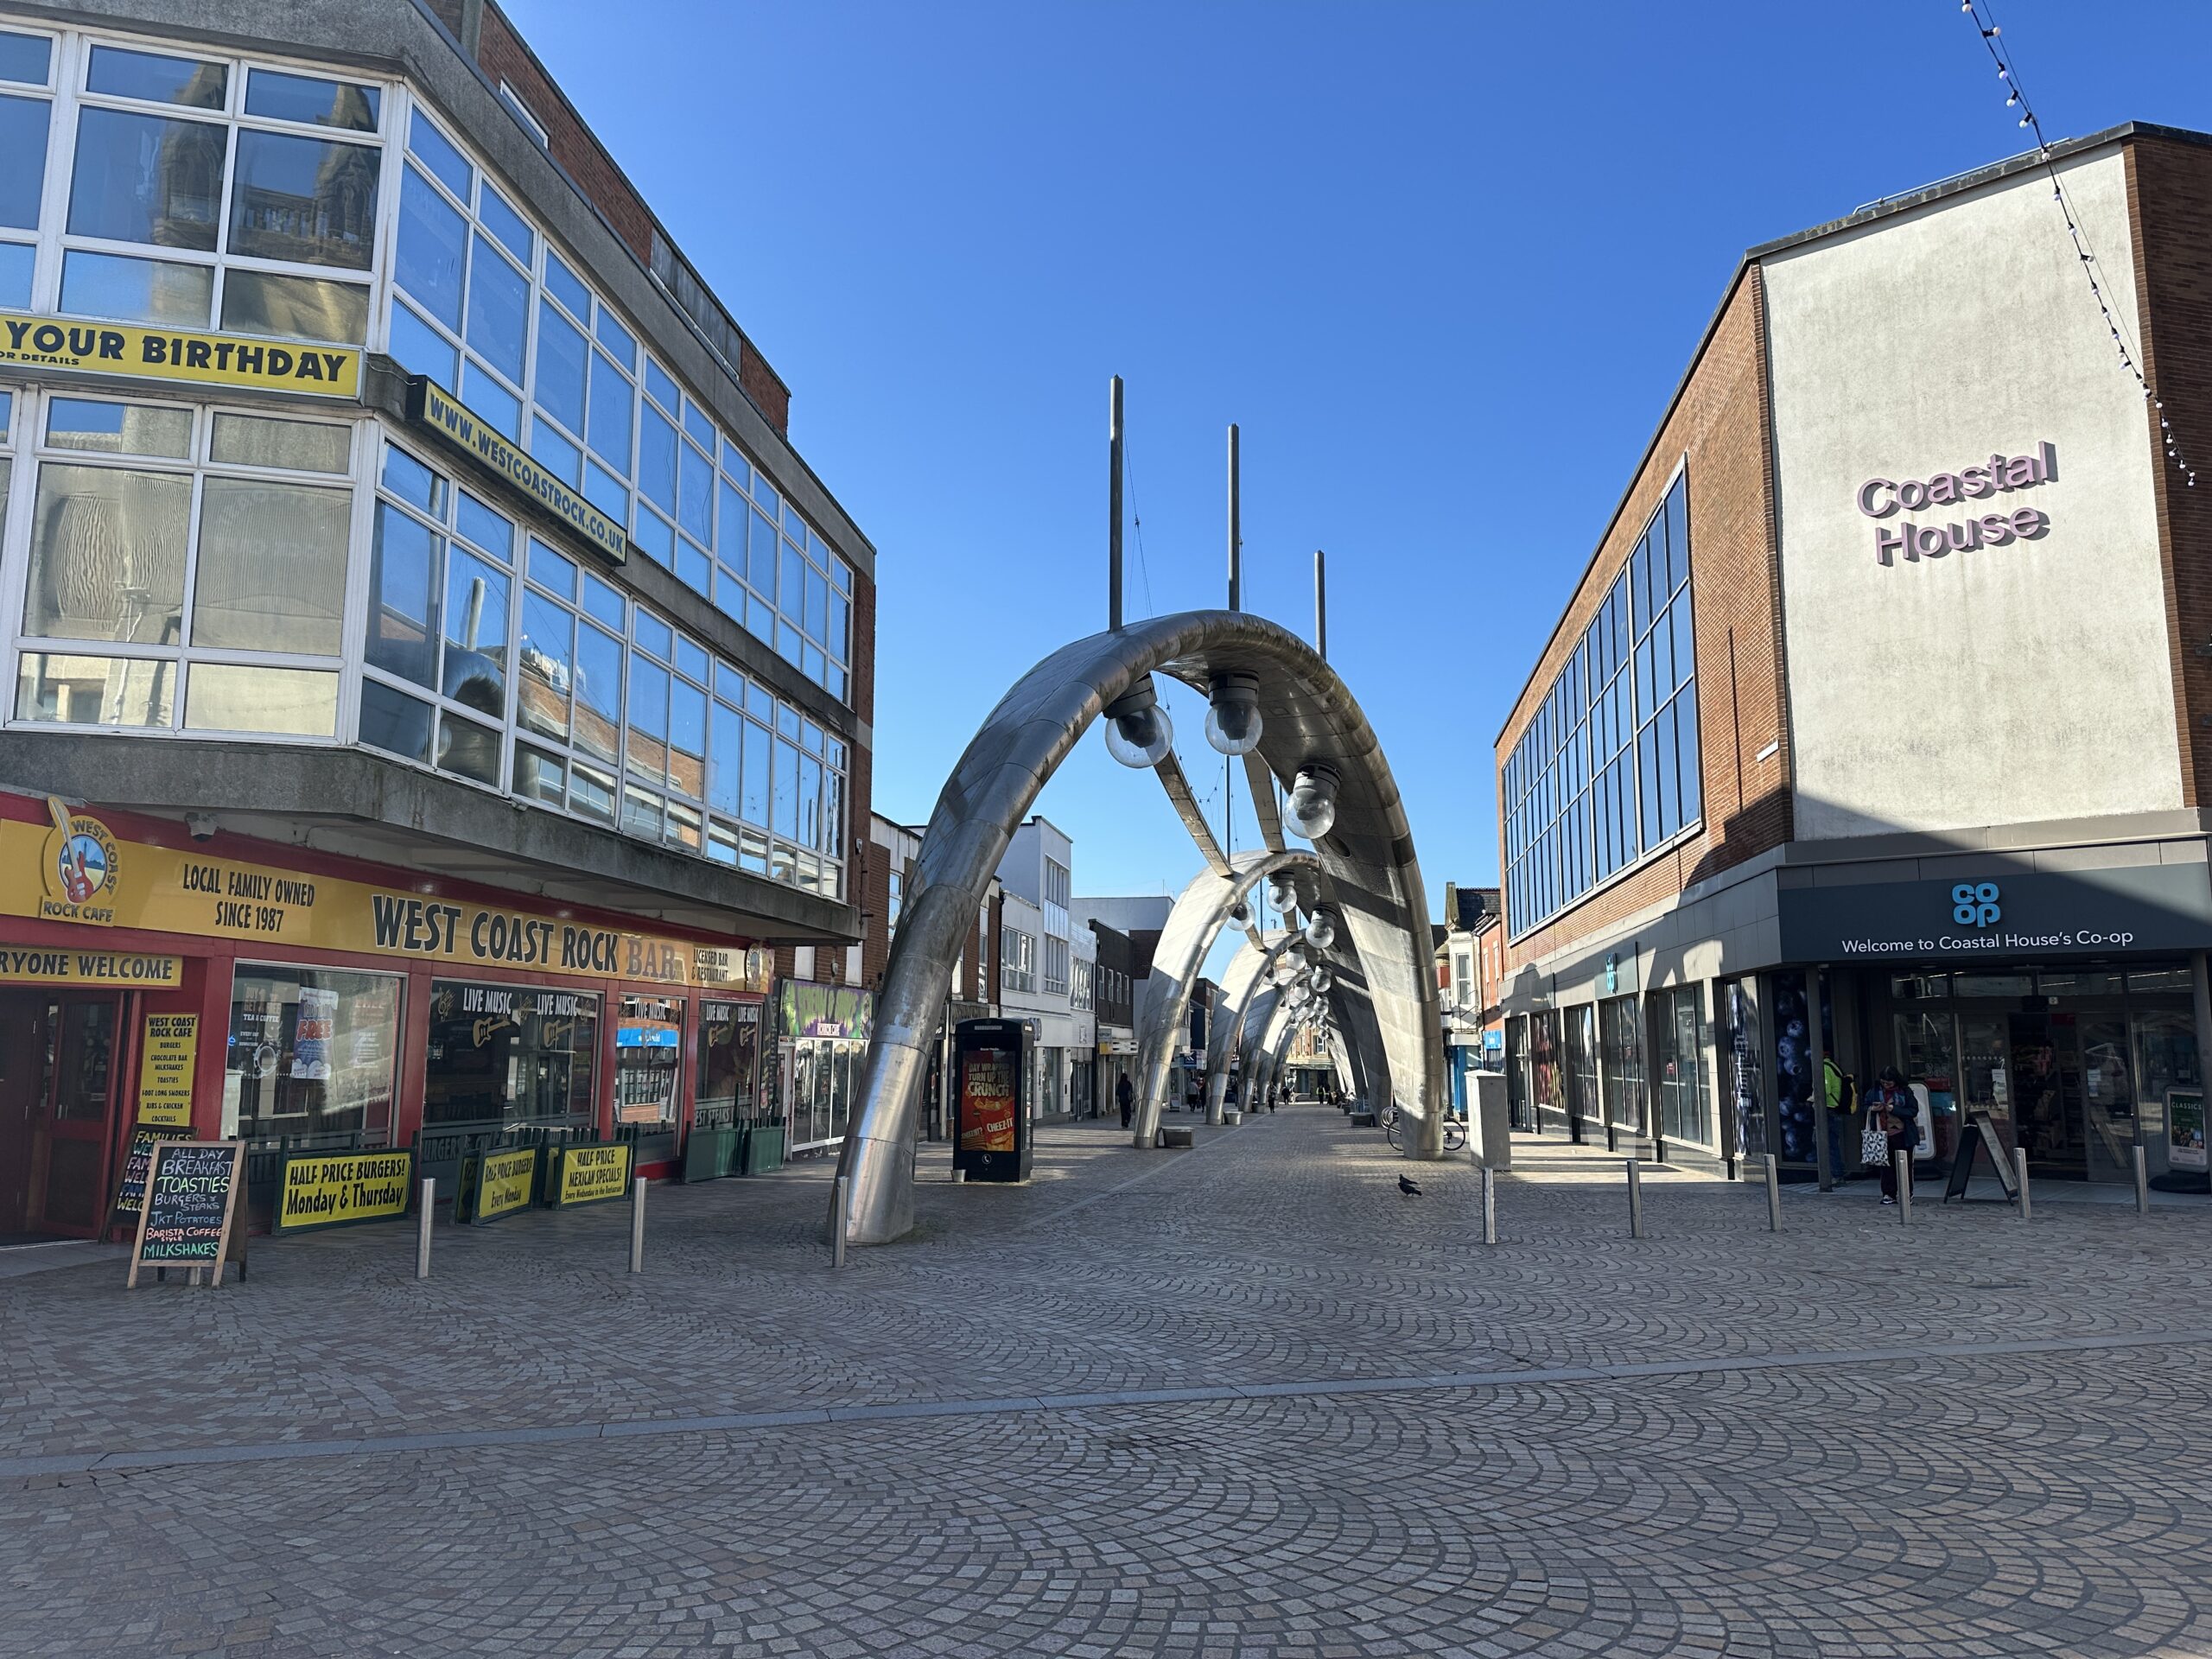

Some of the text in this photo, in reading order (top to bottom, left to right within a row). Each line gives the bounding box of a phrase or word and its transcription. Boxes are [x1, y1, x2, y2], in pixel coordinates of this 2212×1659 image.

[5, 321, 347, 382] YOUR BIRTHDAY
[22, 353, 79, 365] DETAILS
[430, 393, 624, 555] WWW.WESTCOASTROCK.CO.UK
[1857, 441, 2056, 517] Coastal
[1876, 507, 2045, 564] House
[71, 820, 118, 896] WEST COAST
[183, 864, 315, 907] LOCAL FAMILY OWNED
[43, 901, 114, 922] ROCK CAFE
[215, 901, 284, 932] SINCE 1987
[372, 894, 676, 980] WEST COAST ROCK BAR
[1841, 930, 2133, 953] Welcome to Coastal House's Co-op
[693, 949, 728, 966] LICENSED BAR
[78, 955, 173, 980] WELCOME
[697, 966, 728, 982] RESTAURANT
[463, 988, 512, 1014] LIVE MUSIC
[537, 994, 579, 1017] LIVE MUSIC
[259, 1014, 280, 1023] COFFEE
[634, 1002, 666, 1020] LIVE MUSIC
[706, 1004, 729, 1021] LIVE MUSIC
[738, 1006, 747, 1022] LIVE
[148, 1017, 196, 1027] WEST COAST
[296, 1019, 333, 1041] FREE
[149, 1027, 192, 1037] ROCK CAFE
[968, 1072, 986, 1081] TURN
[987, 1071, 996, 1083] UP
[968, 1081, 1010, 1097] CRUNCH
[2171, 1102, 2202, 1110] CLASSICS
[708, 1108, 729, 1125] STEAKS
[172, 1148, 226, 1160] ALL DAY
[577, 1149, 615, 1166] HALF PRICE
[162, 1159, 233, 1176] BREAKFAST
[289, 1159, 406, 1185] HALF PRICE BURGERS!
[156, 1176, 230, 1193] TOASTIES
[569, 1166, 622, 1187] MEXICAN SPECIALS!
[155, 1193, 206, 1207] BURGERS
[181, 1202, 220, 1211] STEAKS
[286, 1182, 404, 1215] Monday & Thursday
[491, 1191, 504, 1209] Every
[150, 1211, 222, 1226] JKT POTATOES
[145, 1226, 222, 1241] BARISTA COFFEE
[143, 1242, 219, 1260] MILKSHAKES
